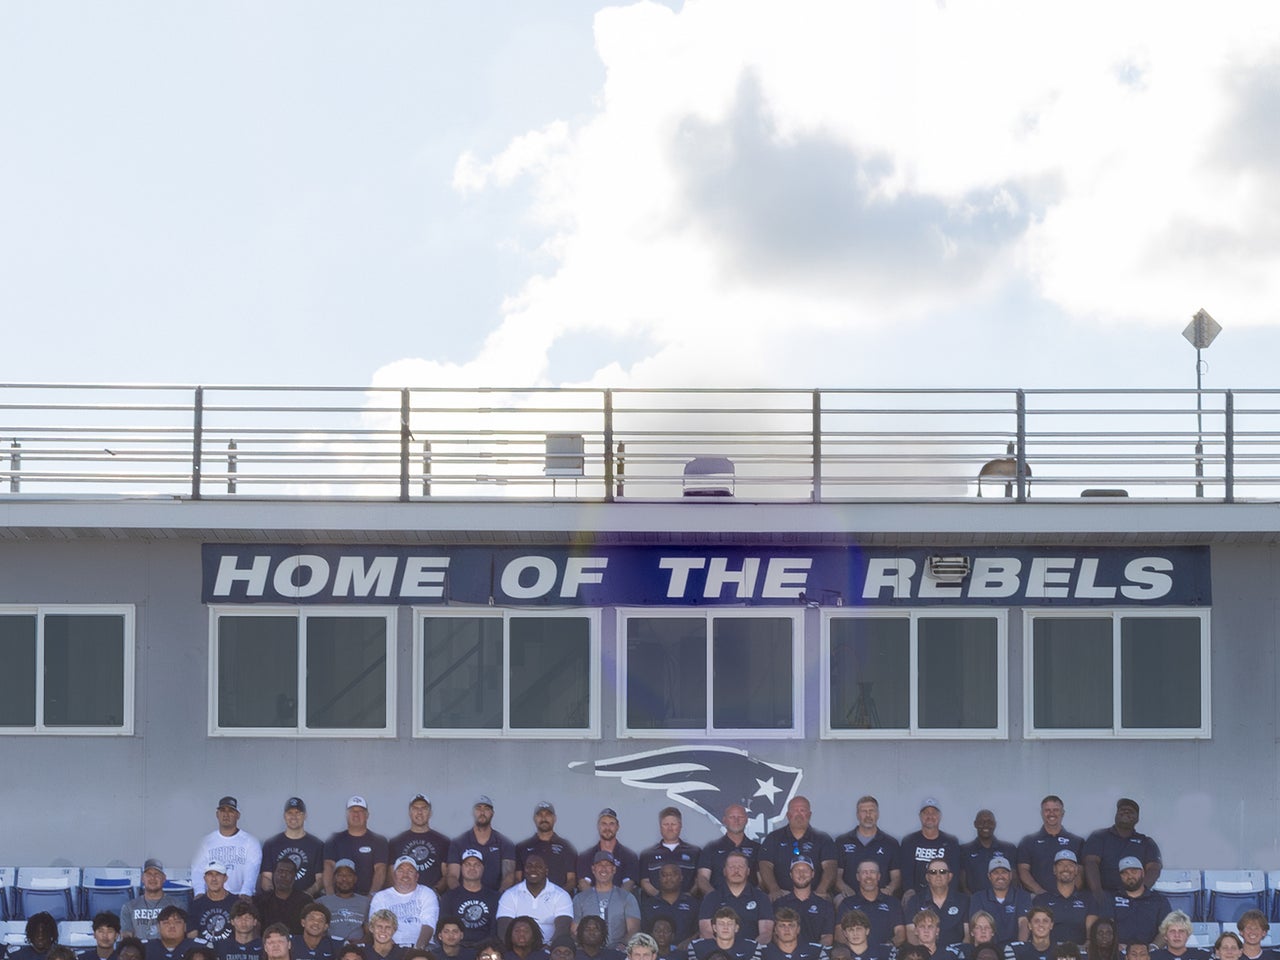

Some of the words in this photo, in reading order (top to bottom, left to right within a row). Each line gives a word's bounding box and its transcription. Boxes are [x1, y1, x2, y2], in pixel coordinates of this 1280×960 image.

[213, 555, 451, 597] HOME
[500, 556, 609, 599] OF
[659, 558, 813, 598] THE
